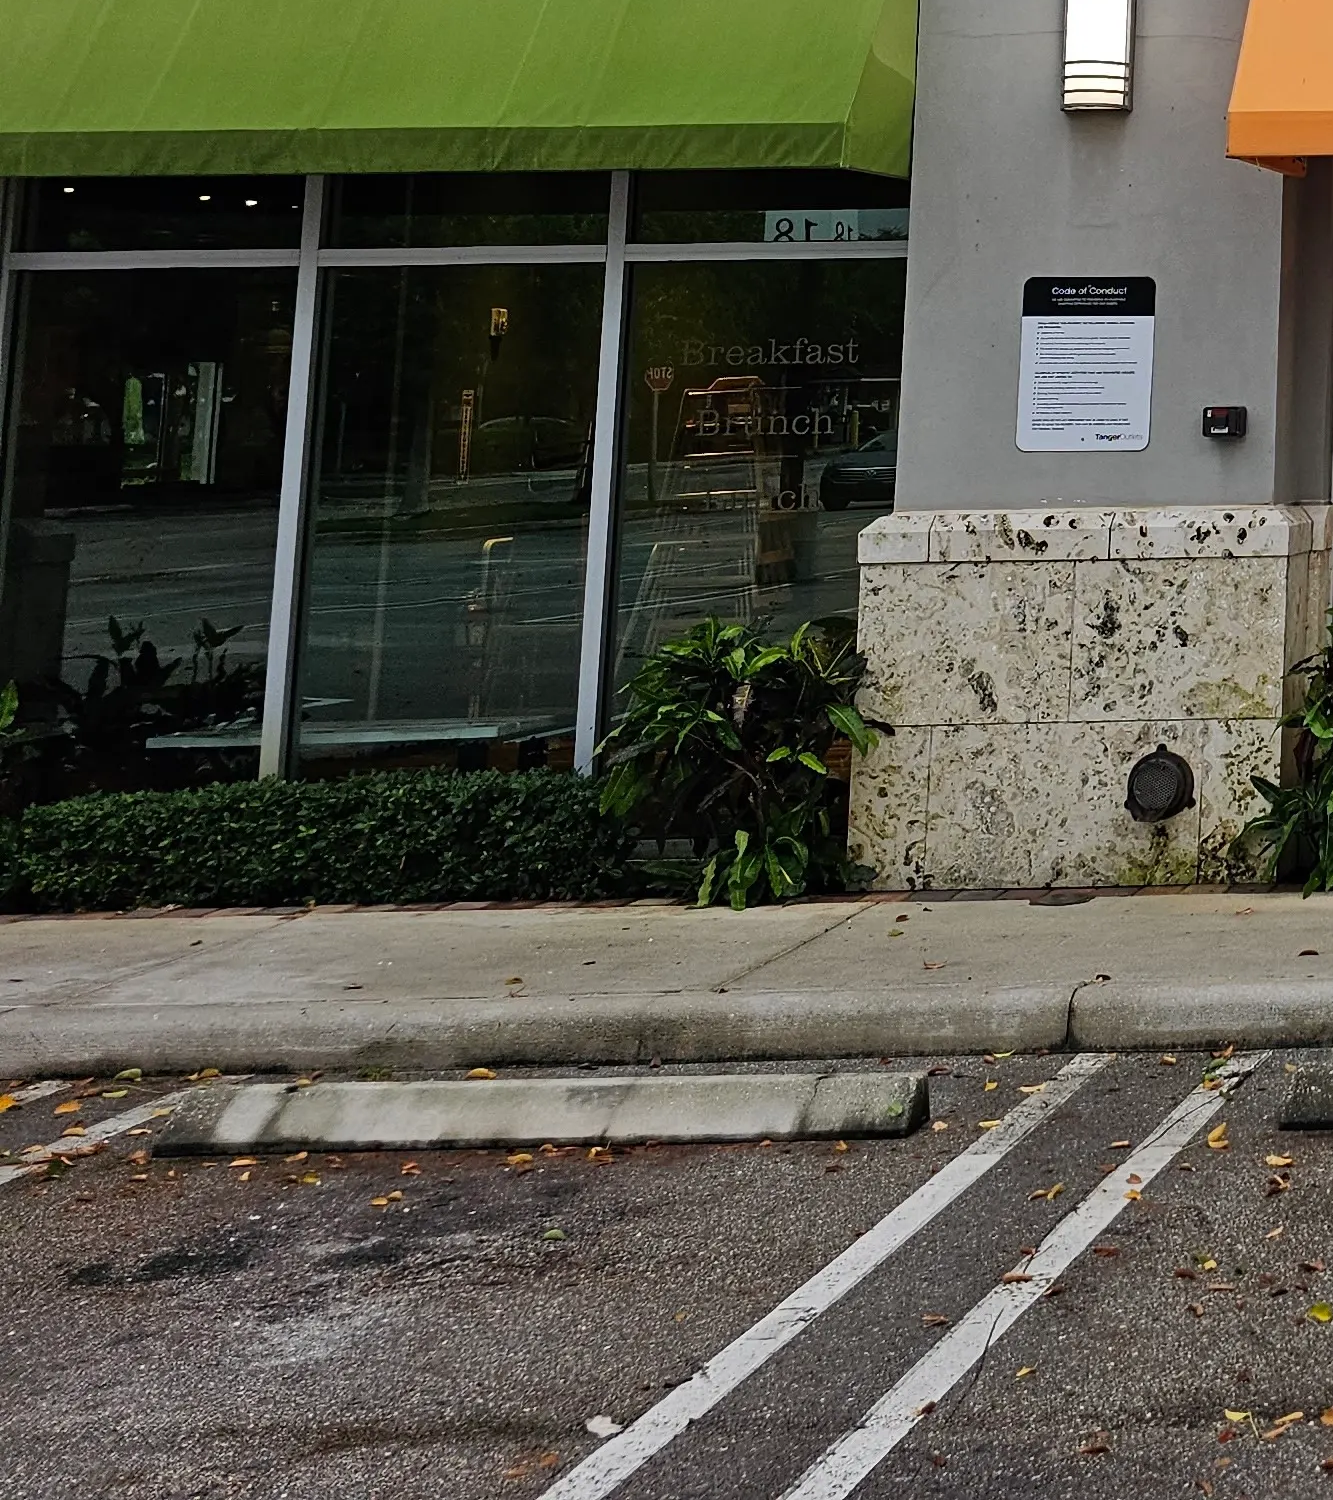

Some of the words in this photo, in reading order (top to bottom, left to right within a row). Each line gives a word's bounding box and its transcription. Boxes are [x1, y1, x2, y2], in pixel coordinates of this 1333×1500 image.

[1051, 286, 1077, 296] Code
[1078, 286, 1088, 296] of
[1089, 286, 1128, 296] Conduct
[680, 337, 860, 367] Breakfast
[694, 407, 836, 438] Brunch
